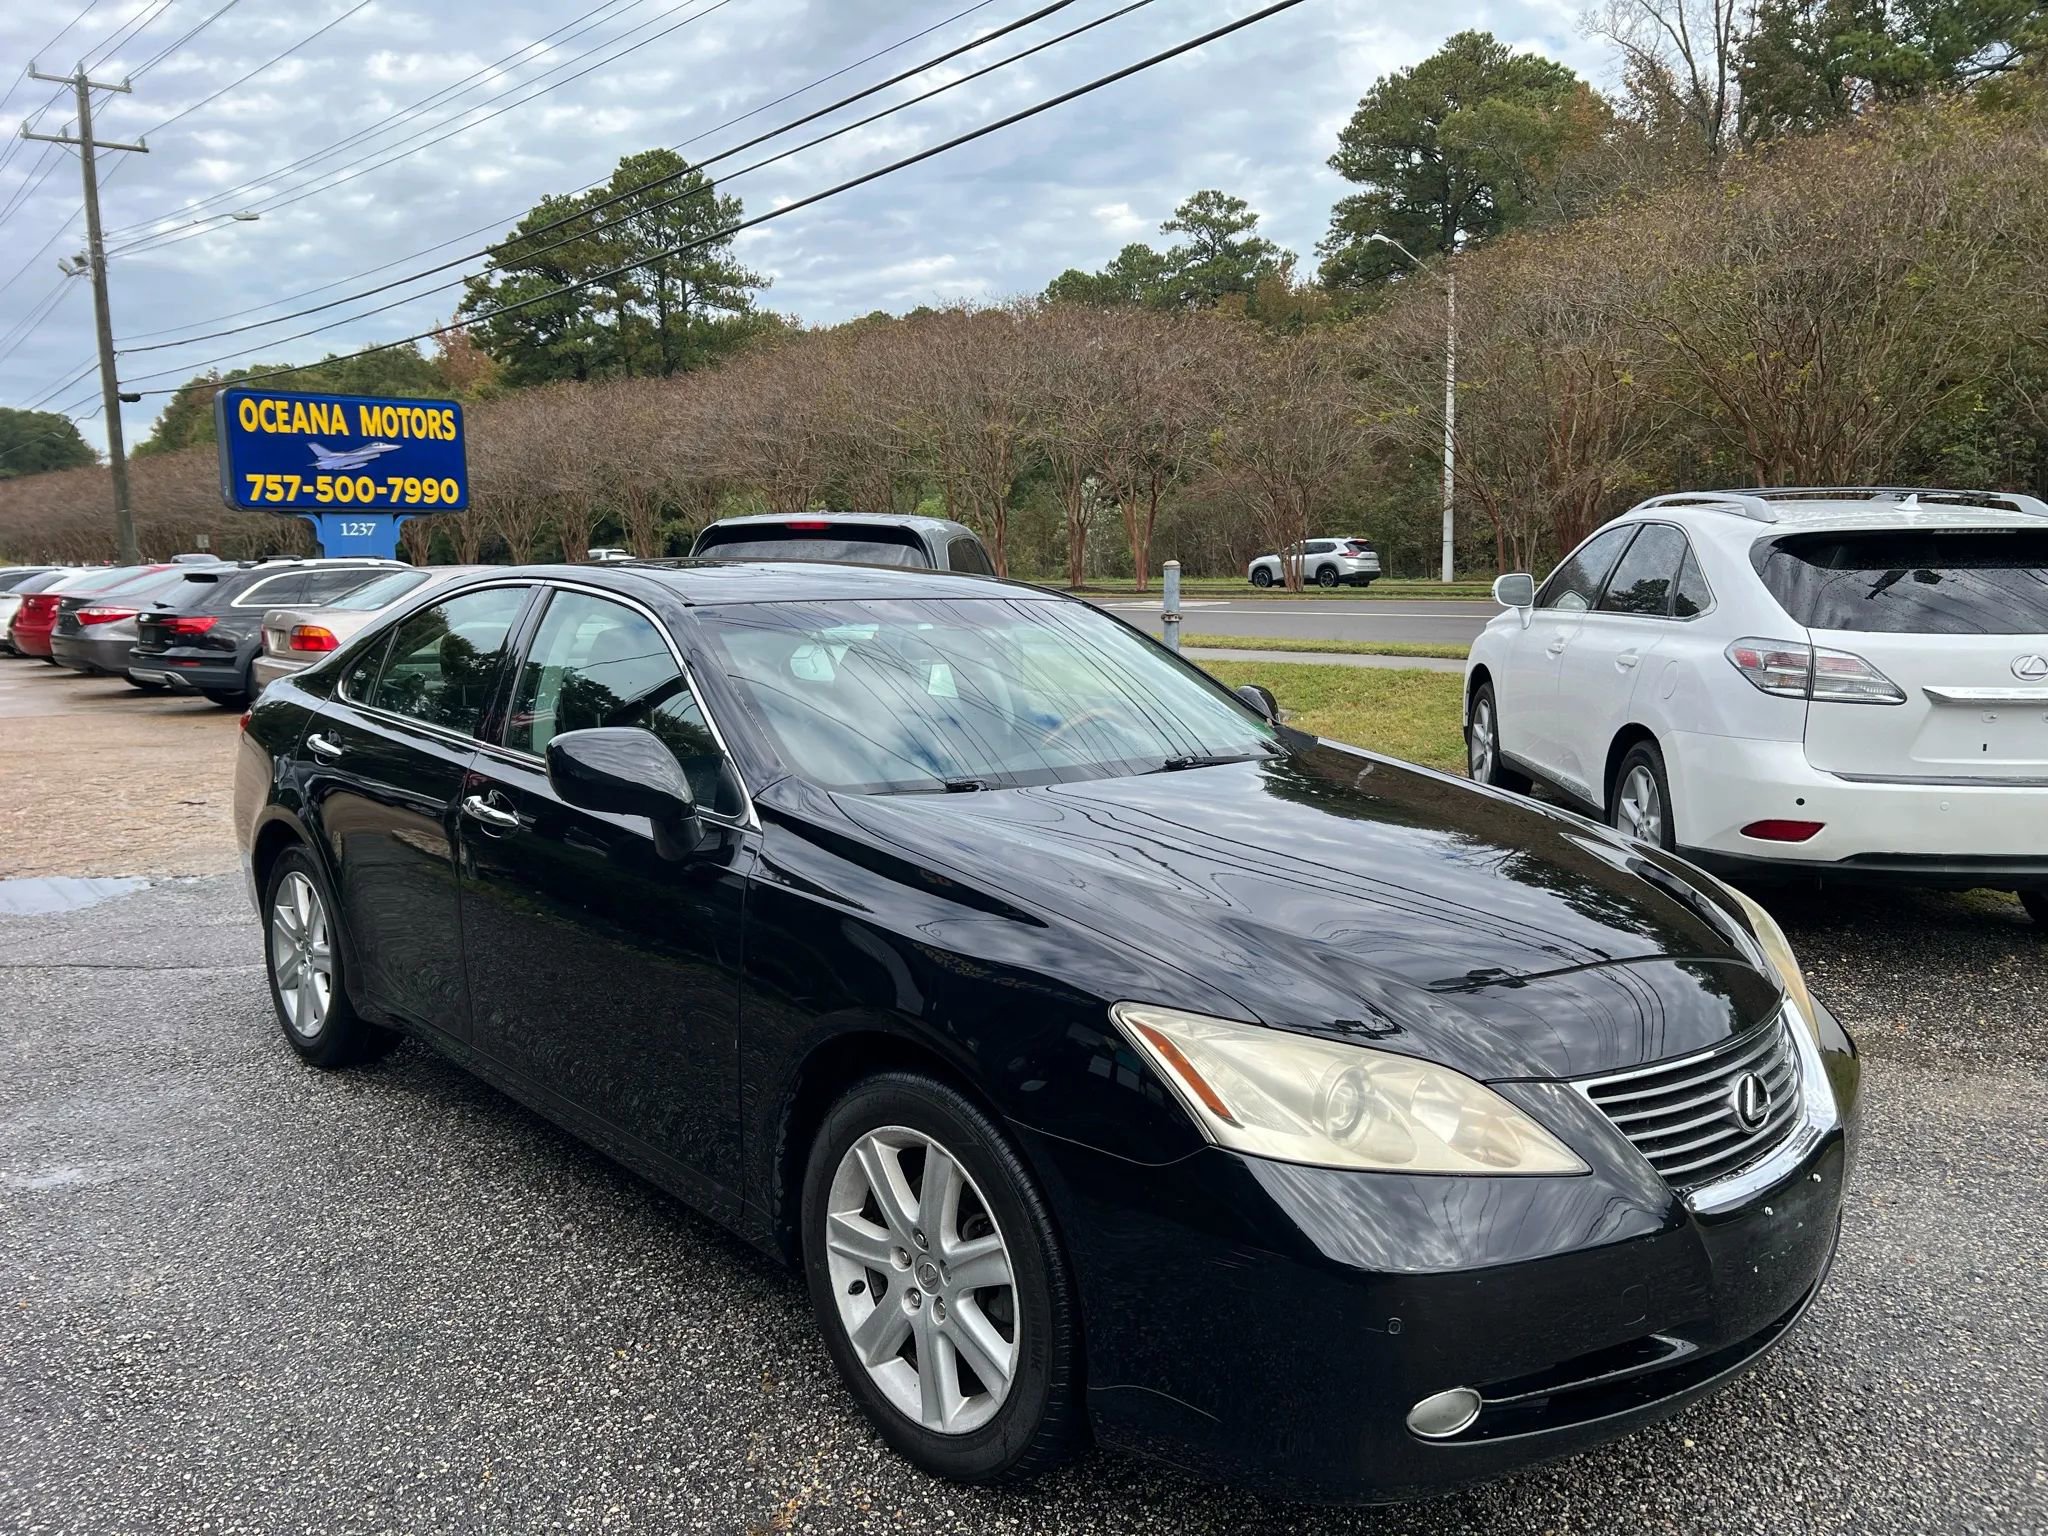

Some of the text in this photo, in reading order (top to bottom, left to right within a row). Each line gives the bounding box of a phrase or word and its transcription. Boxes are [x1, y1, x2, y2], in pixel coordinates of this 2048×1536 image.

[239, 398, 456, 441] OCEANA MOTORS
[246, 474, 459, 504] 757-500-7990
[340, 522, 376, 536] 1237
